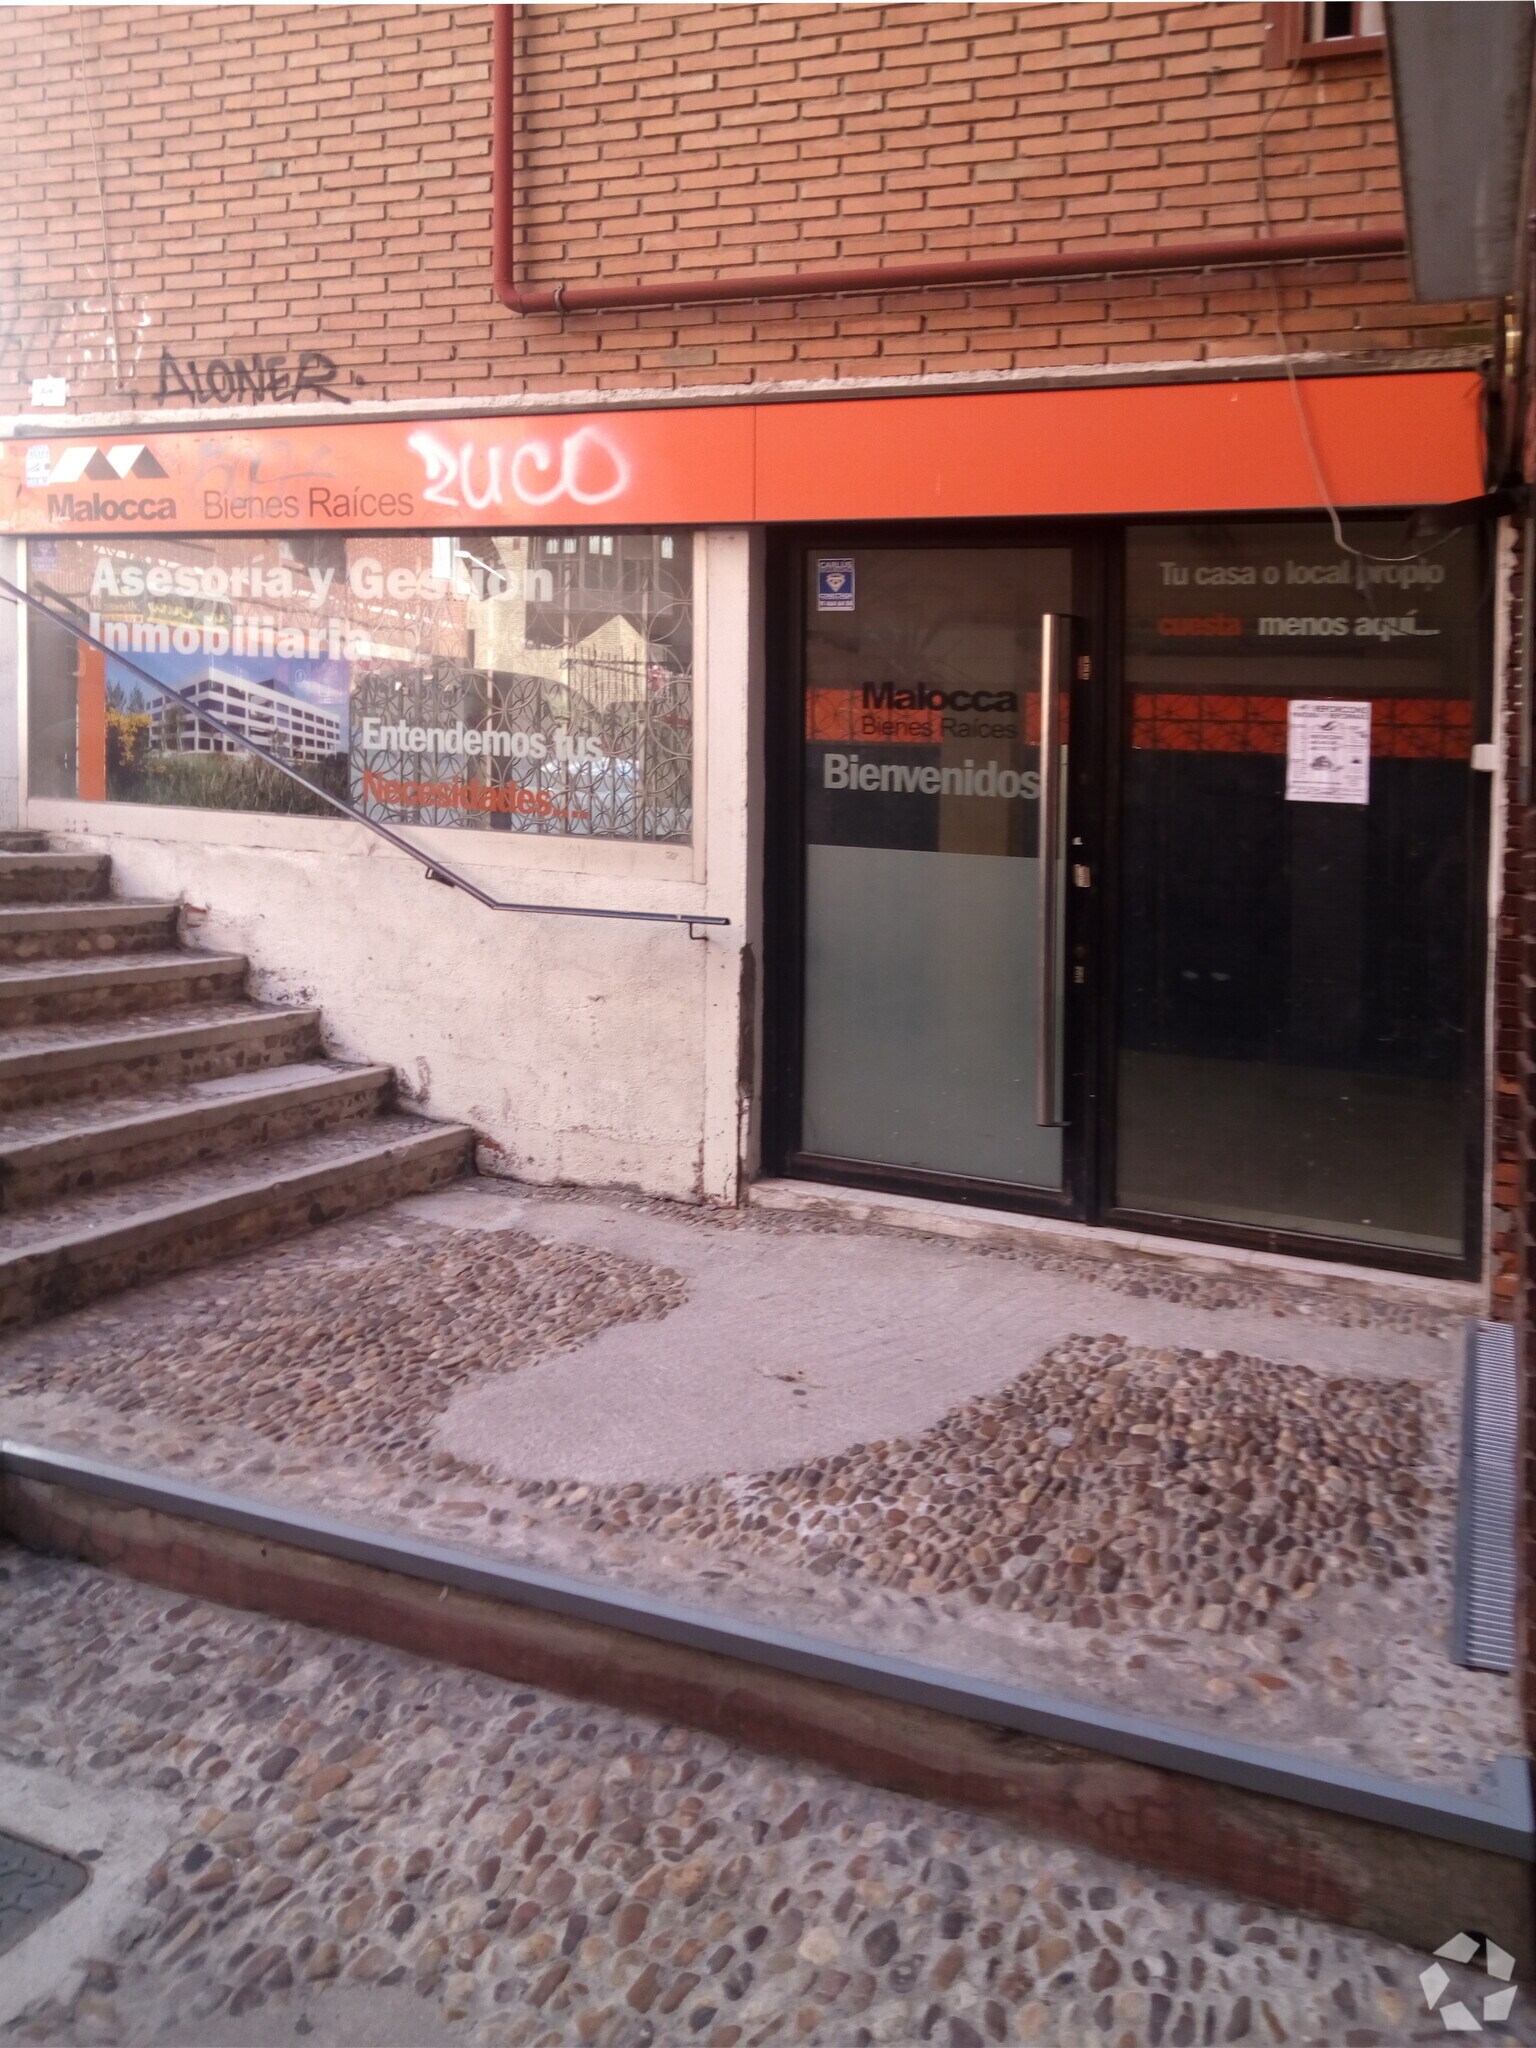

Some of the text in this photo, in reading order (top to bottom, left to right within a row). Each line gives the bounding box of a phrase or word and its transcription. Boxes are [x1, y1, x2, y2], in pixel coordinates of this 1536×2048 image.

[47, 492, 177, 522] Malocca
[203, 486, 414, 520] Bienes Raíces
[90, 554, 294, 599] Asesoría
[307, 566, 336, 609] y
[1159, 558, 1447, 590] Tu casa o local propio
[89, 612, 373, 662] Inmobiliaria
[1258, 616, 1349, 636] menos
[862, 681, 1018, 713] Malocca
[362, 717, 604, 763] Entendemos tus
[862, 714, 1018, 740] Bienes Raíces
[823, 752, 1042, 800] Bienvenidos
